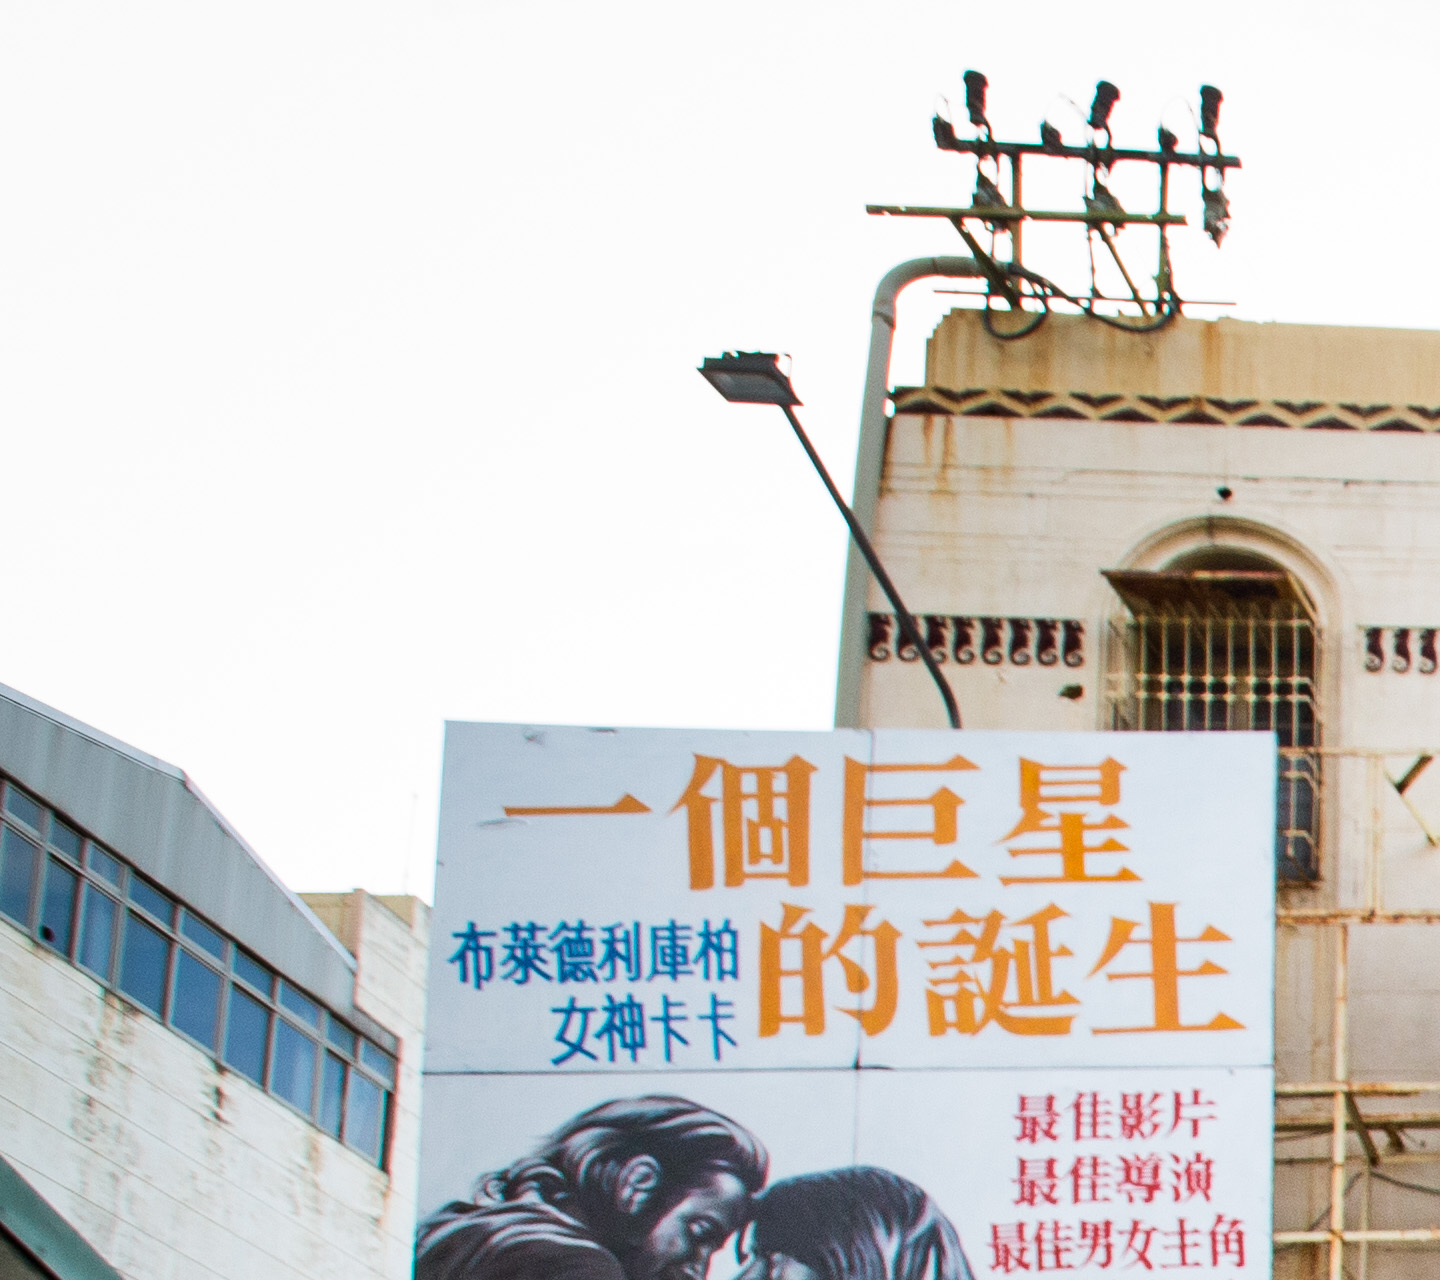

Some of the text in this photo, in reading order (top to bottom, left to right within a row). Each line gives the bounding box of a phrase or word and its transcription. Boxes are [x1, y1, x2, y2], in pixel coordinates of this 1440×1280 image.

[502, 753, 1144, 891] 一個巨星
[447, 918, 740, 991] 布萊德利庫柏
[757, 900, 1247, 1038] 的誕生
[550, 991, 738, 1066] 女神卡卡
[1013, 1088, 1217, 1143] 最佳影片
[1010, 1151, 1215, 1206] 最佳導演
[987, 1213, 1246, 1274] 最佳男女主角
